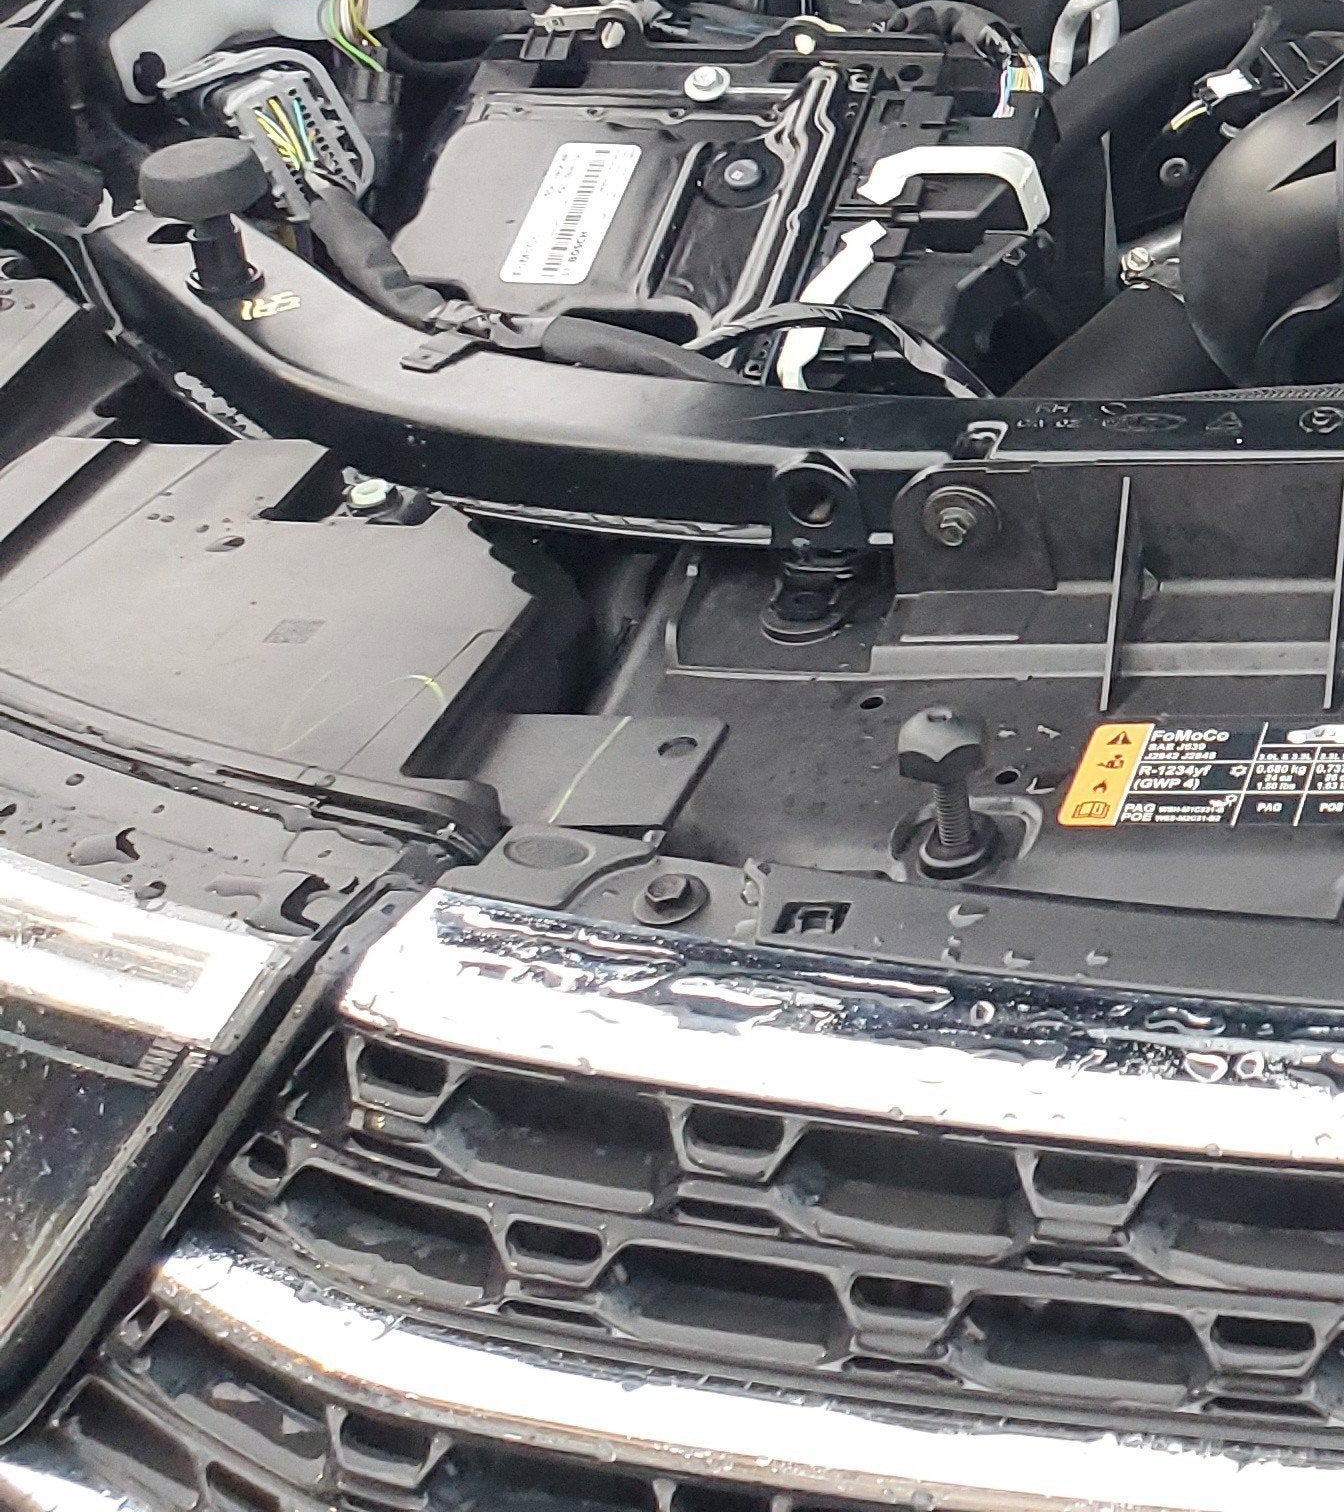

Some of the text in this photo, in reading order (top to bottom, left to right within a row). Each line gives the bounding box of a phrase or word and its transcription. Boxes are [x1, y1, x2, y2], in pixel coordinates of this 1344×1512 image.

[568, 231, 588, 262] BOSCH
[1151, 729, 1230, 742] FoMoCo
[1148, 742, 1175, 751] SAE
[1138, 764, 1212, 777] R-1234yf
[1290, 764, 1307, 776] kg
[1133, 778, 1201, 790] (GWP 4)
[1124, 803, 1157, 813] PAG
[1256, 802, 1282, 812] PAG
[1319, 802, 1344, 812] POE
[1120, 812, 1154, 822] POE
